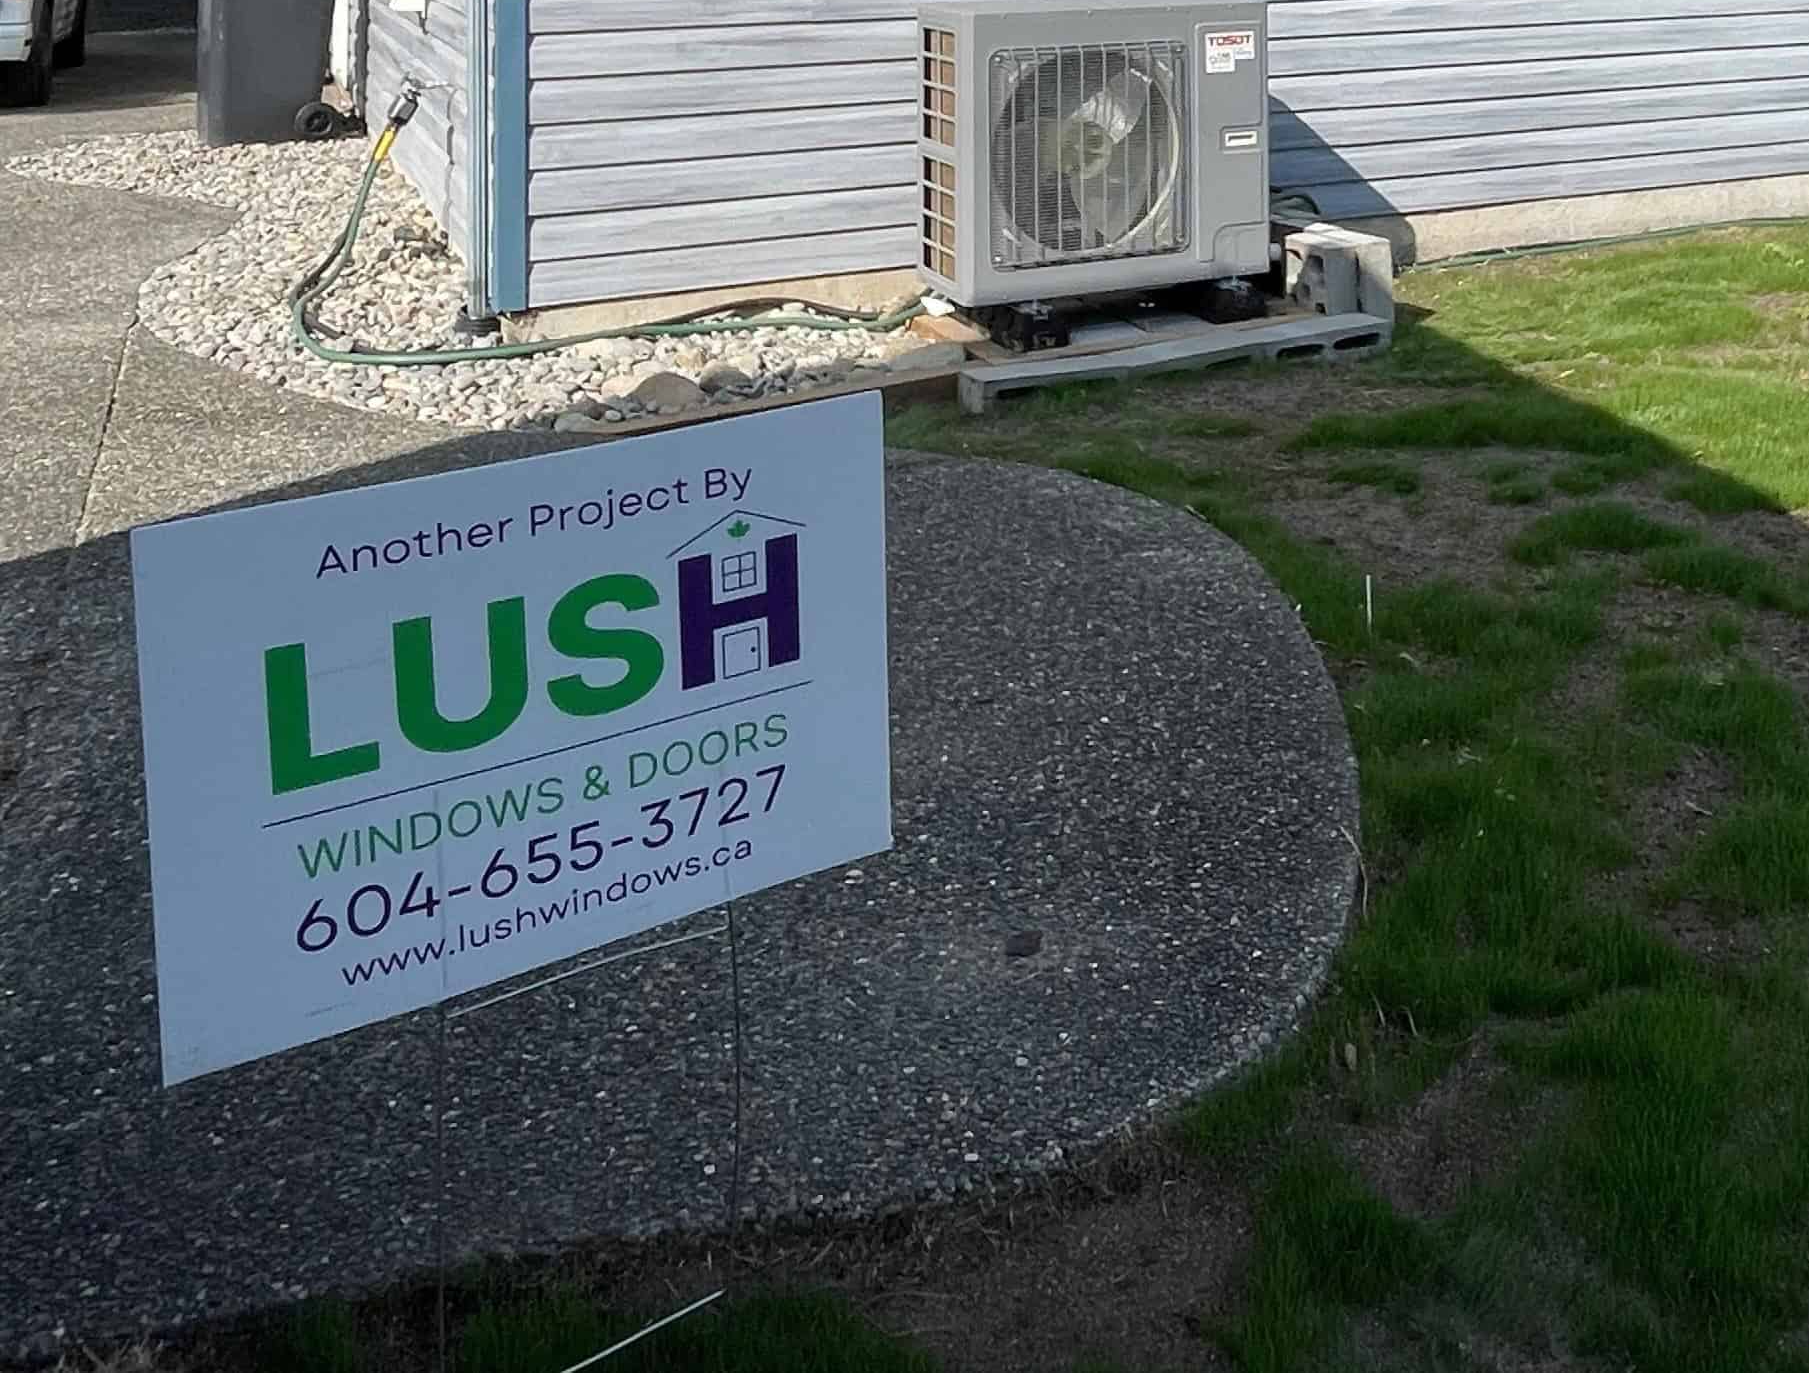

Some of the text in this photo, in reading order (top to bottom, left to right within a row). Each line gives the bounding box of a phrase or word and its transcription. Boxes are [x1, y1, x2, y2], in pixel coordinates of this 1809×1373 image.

[315, 467, 753, 580] Another Project By
[263, 532, 801, 796] LUSH
[296, 713, 789, 879] WINDOWS & DOORS
[296, 763, 787, 953] 604-655-3727
[341, 839, 752, 986] www.lushwindows.ca
